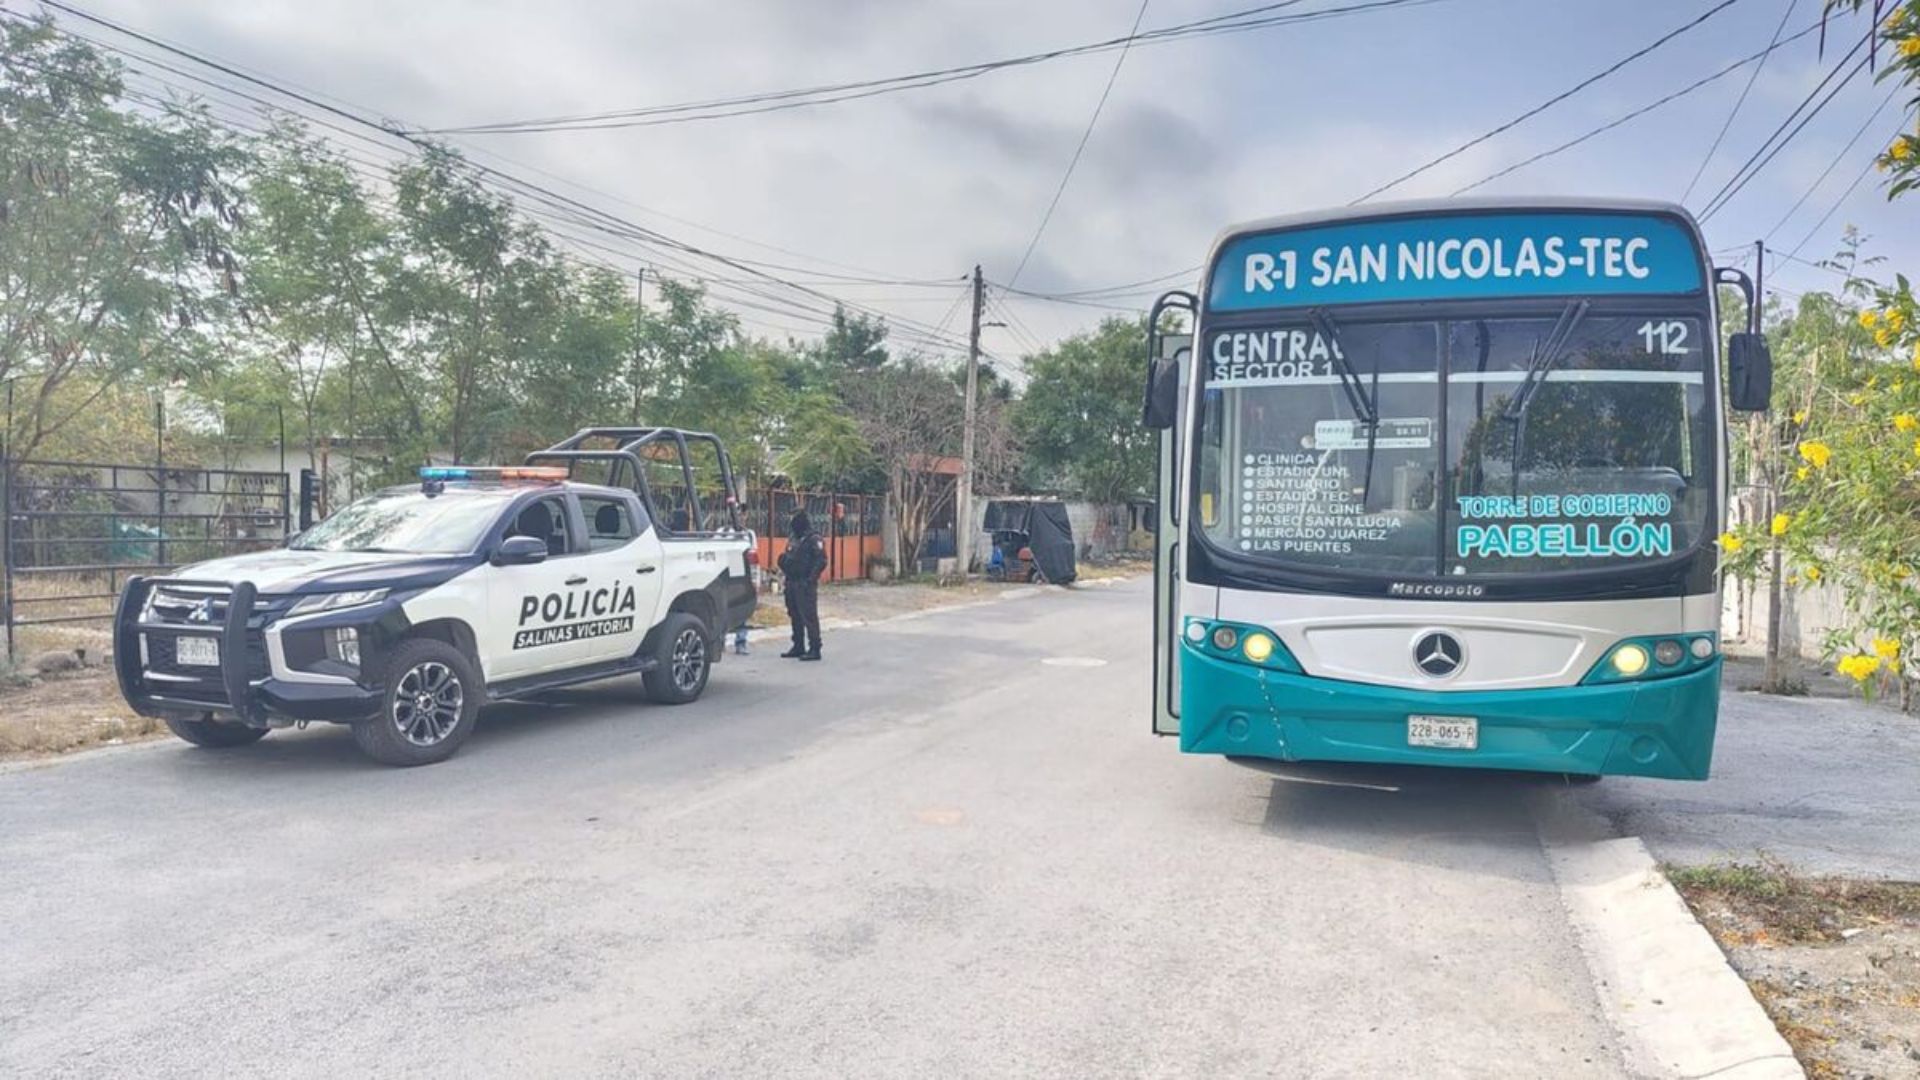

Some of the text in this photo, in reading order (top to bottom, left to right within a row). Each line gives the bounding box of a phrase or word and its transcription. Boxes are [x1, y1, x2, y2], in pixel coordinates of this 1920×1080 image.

[1244, 236, 1650, 292] R-1 SAN NICOLAS-TEC
[1637, 321, 1689, 355] 112
[1215, 361, 1333, 381] SECTOR 1
[1257, 454, 1315, 464] CLINICA
[1257, 466, 1317, 477] ESTADIO
[1256, 479, 1340, 489] SANTUARIO
[1255, 490, 1350, 502] ESTADIO TEC
[1255, 503, 1326, 514] HOSPITAL
[1457, 493, 1671, 517] TORRE DE GOBIERNO
[1254, 515, 1401, 528] PASEO SANTA LUCIA
[1254, 527, 1388, 541] MERCADO JUAREZ
[1457, 517, 1672, 557] PABELLÓN
[1253, 540, 1352, 553] LAS PUENTES
[518, 579, 636, 626] POLICÍA
[516, 618, 632, 647] SALINAS VICTORIA
